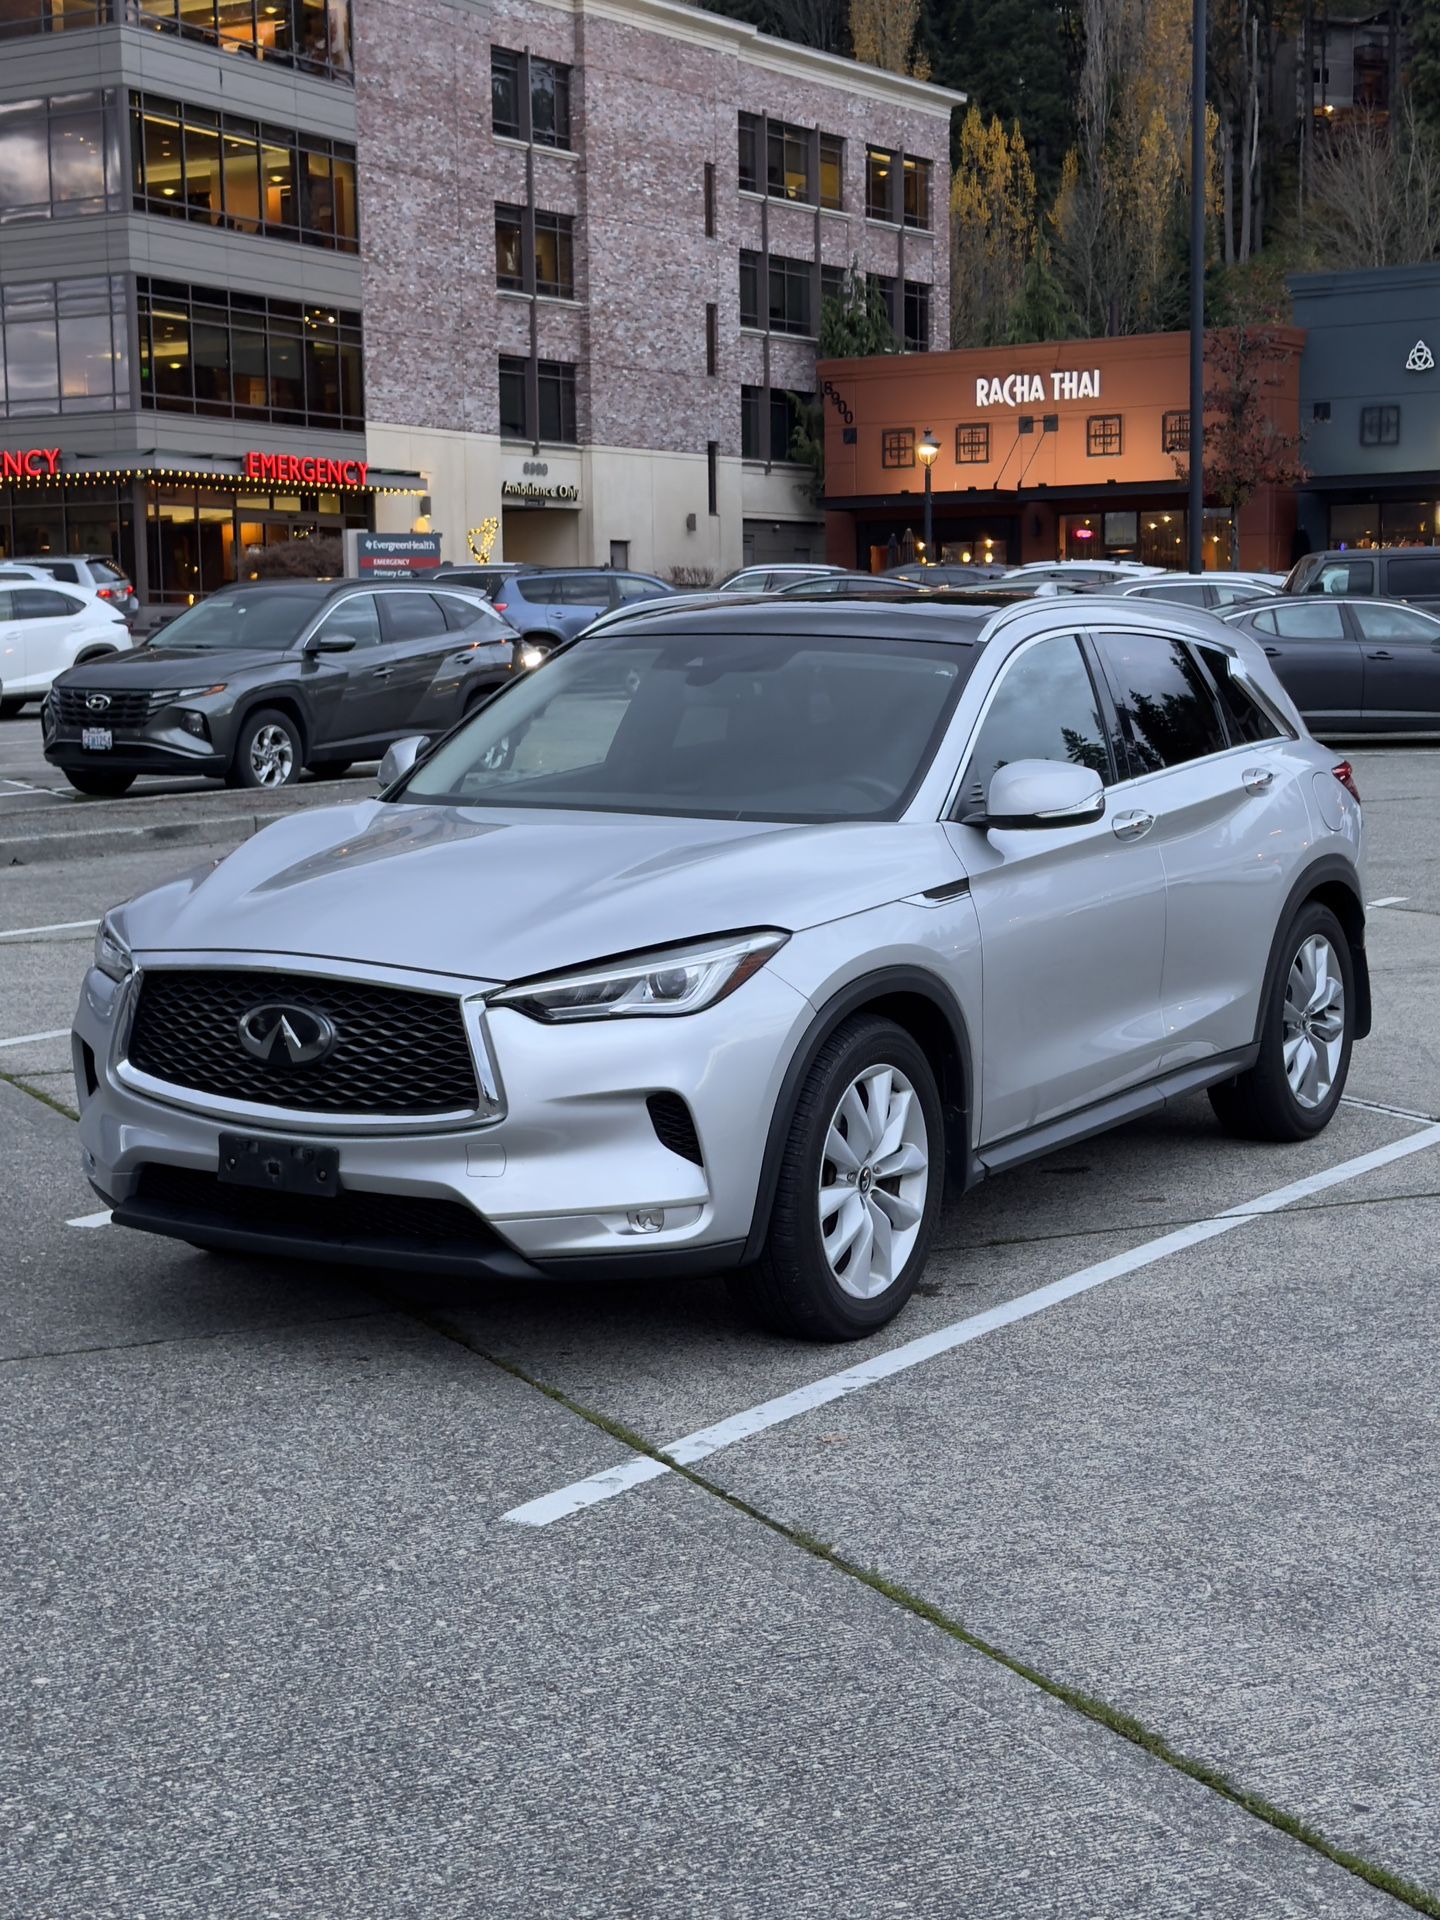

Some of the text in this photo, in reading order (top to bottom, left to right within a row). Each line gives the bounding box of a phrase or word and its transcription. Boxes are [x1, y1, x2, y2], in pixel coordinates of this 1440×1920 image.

[976, 369, 1100, 407] RACHA THAI
[824, 380, 854, 425] 8900
[0, 447, 60, 477] NCY
[246, 451, 369, 486] EMERGENCY
[503, 481, 579, 501] Ambulance Only
[373, 540, 435, 552] EvergreenHealth
[373, 558, 410, 566] EMERGENCY
[373, 569, 412, 578] Primary Care
